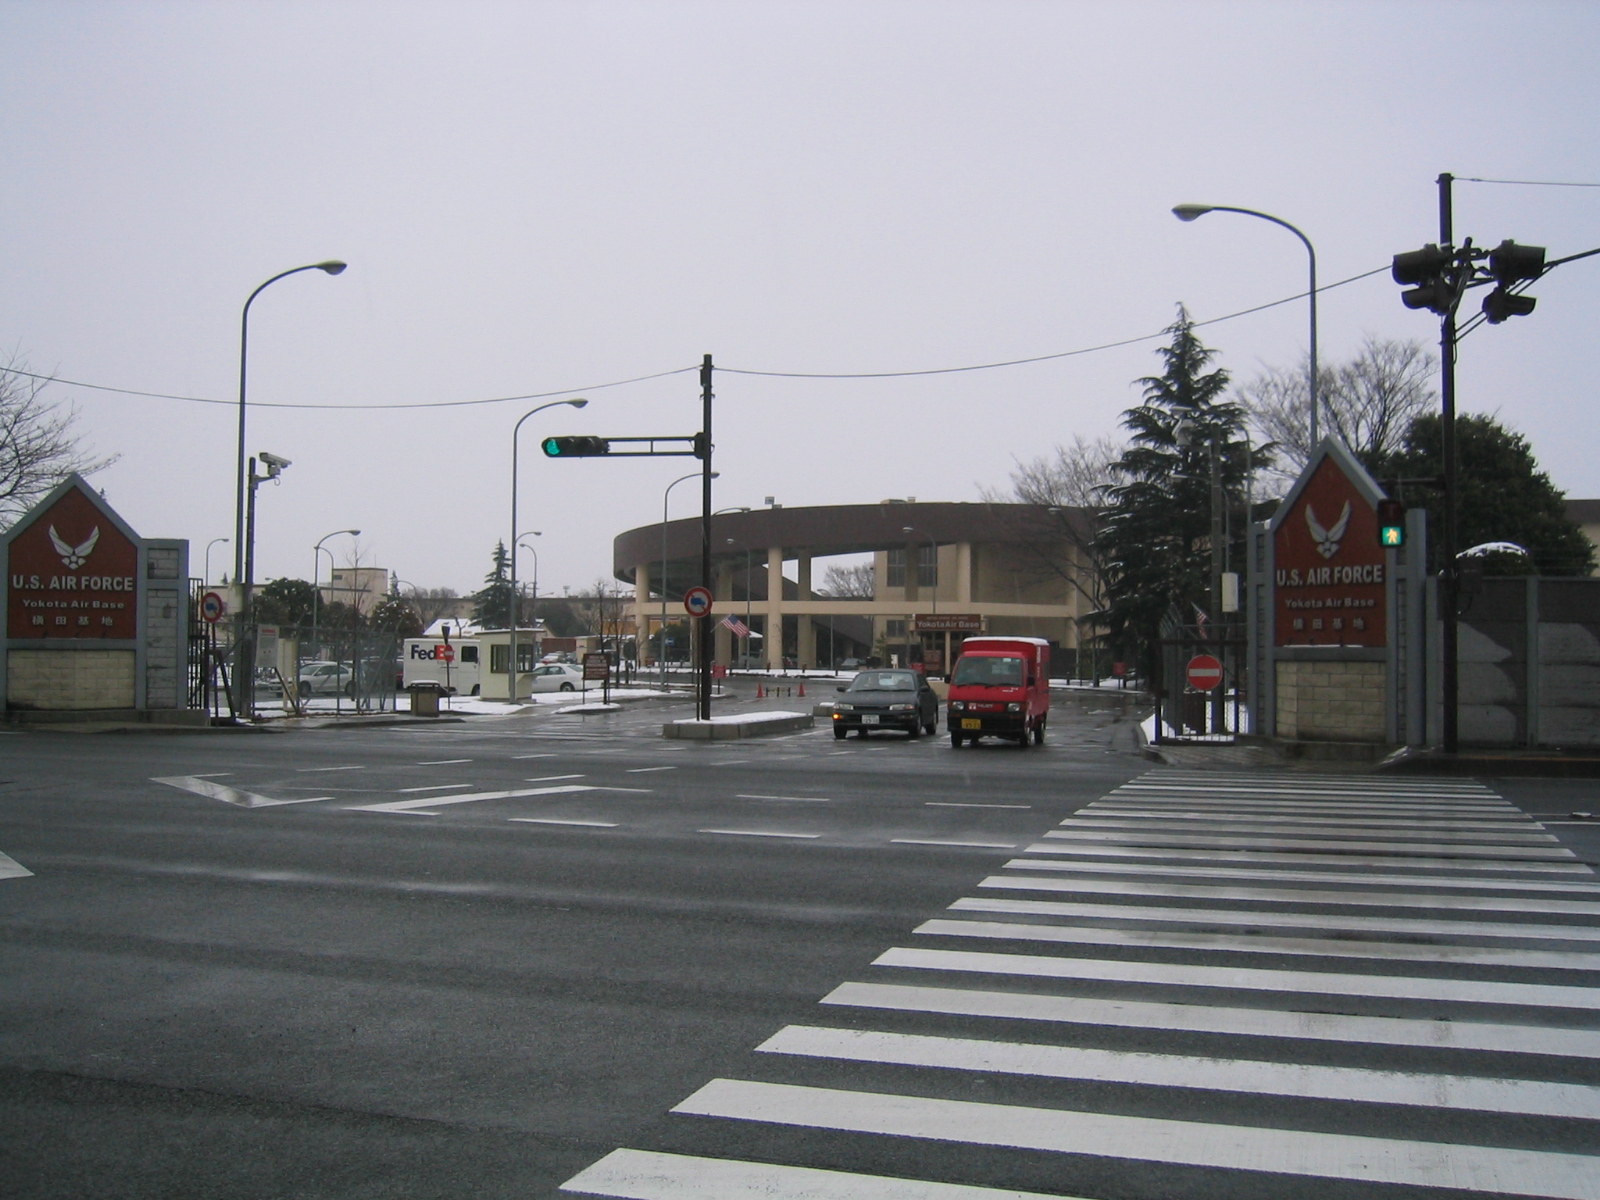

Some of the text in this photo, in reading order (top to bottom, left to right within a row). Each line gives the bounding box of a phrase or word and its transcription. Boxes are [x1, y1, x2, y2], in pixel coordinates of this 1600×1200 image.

[1277, 564, 1383, 586] U.S. AIR FORCE
[13, 575, 134, 591] U.S. AIR FORCE
[23, 600, 125, 609] Yokota Air Base
[1285, 597, 1375, 608] Yokota Air Base
[917, 620, 945, 628] Yokota
[411, 644, 455, 660] FedE
